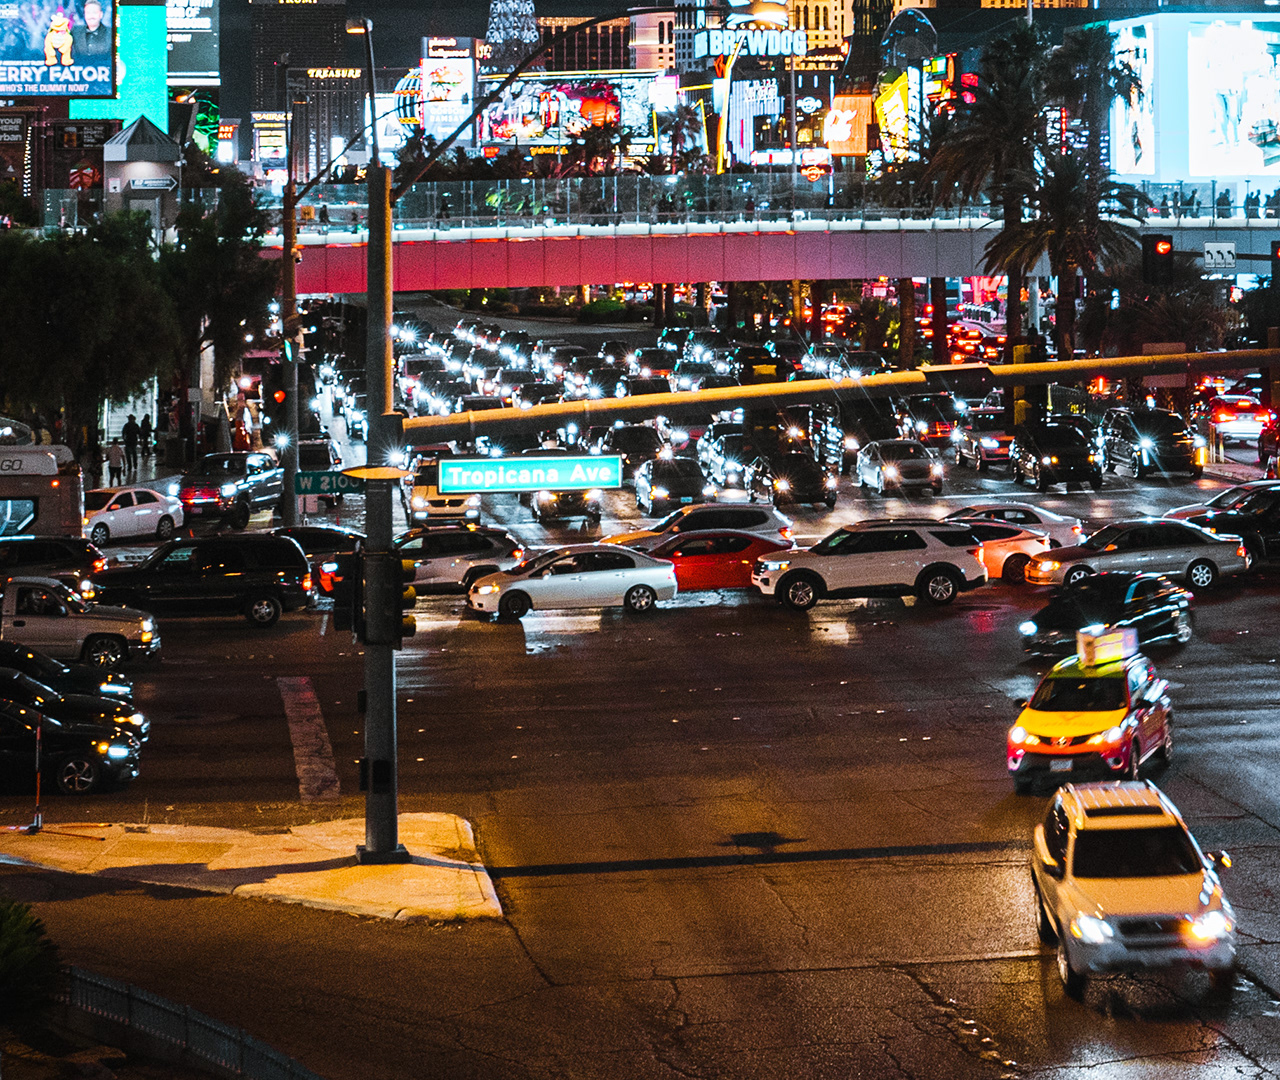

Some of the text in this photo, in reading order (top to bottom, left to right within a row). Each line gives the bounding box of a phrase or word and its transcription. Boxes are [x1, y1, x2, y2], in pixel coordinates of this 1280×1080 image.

[709, 29, 807, 56] BREWDOG
[50, 66, 110, 82] FATOR
[307, 69, 361, 79] TREASURE
[24, 84, 38, 92] THE
[39, 84, 66, 92] DUMMY
[68, 84, 89, 92] NOW?
[0, 458, 24, 471] GO.
[299, 474, 360, 490] W 2100
[448, 464, 611, 488] Tropicana Ave
